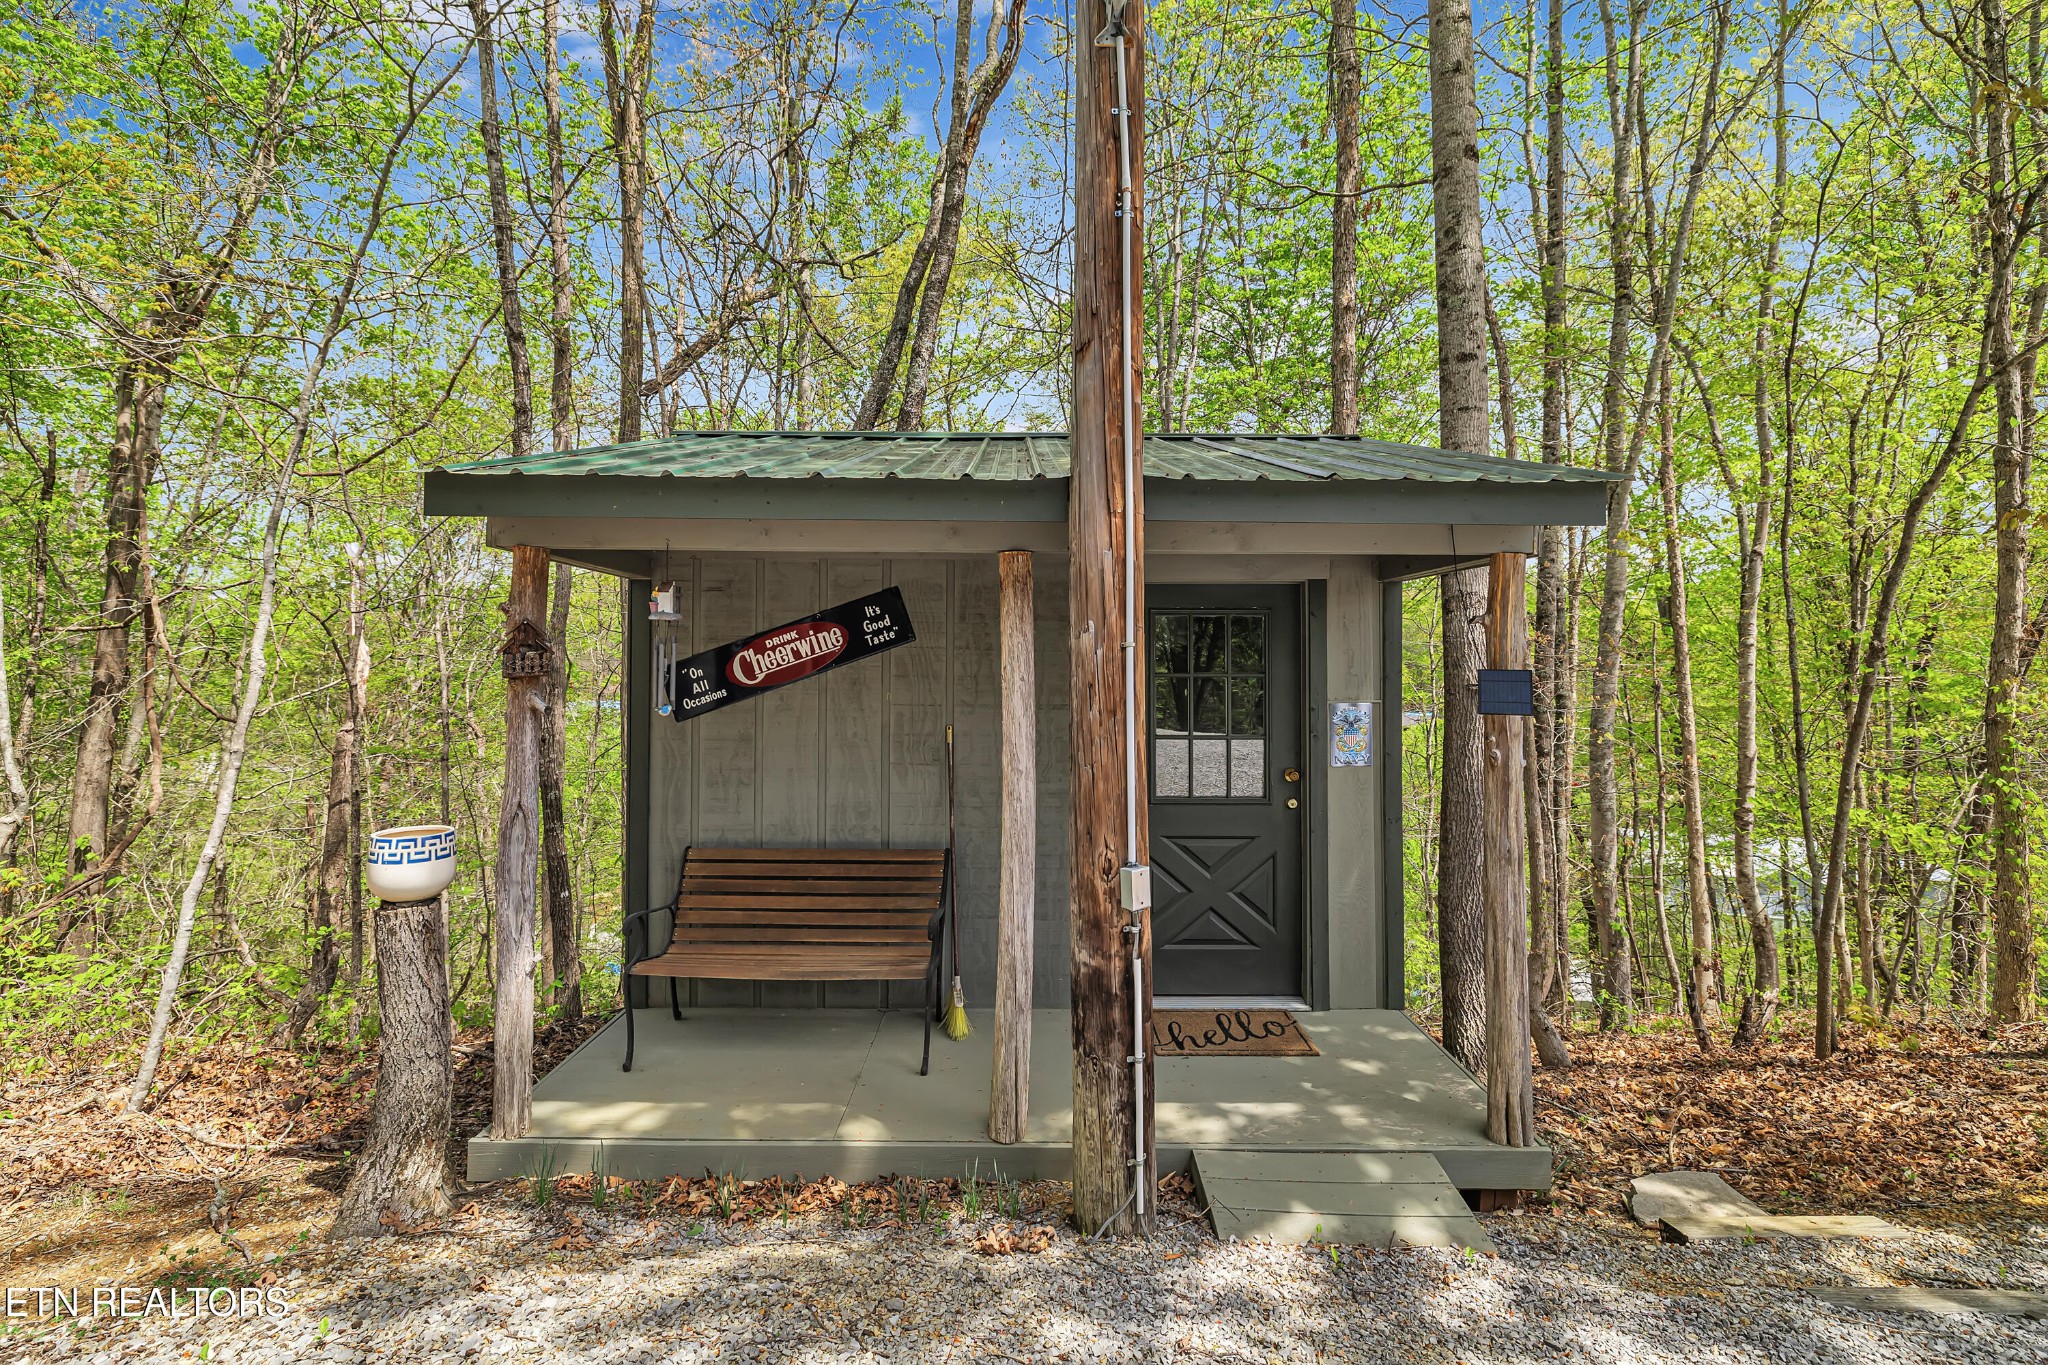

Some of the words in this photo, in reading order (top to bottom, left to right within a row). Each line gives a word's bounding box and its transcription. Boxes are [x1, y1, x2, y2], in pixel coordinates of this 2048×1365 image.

[865, 605, 881, 617] It's
[863, 615, 891, 632] Good
[765, 630, 799, 648] DRINK
[732, 627, 843, 684] Cheerwine
[692, 680, 709, 694] All
[683, 687, 727, 709] Occasions
[1334, 753, 1370, 765] NAVY
[1154, 1011, 1297, 1050] hello
